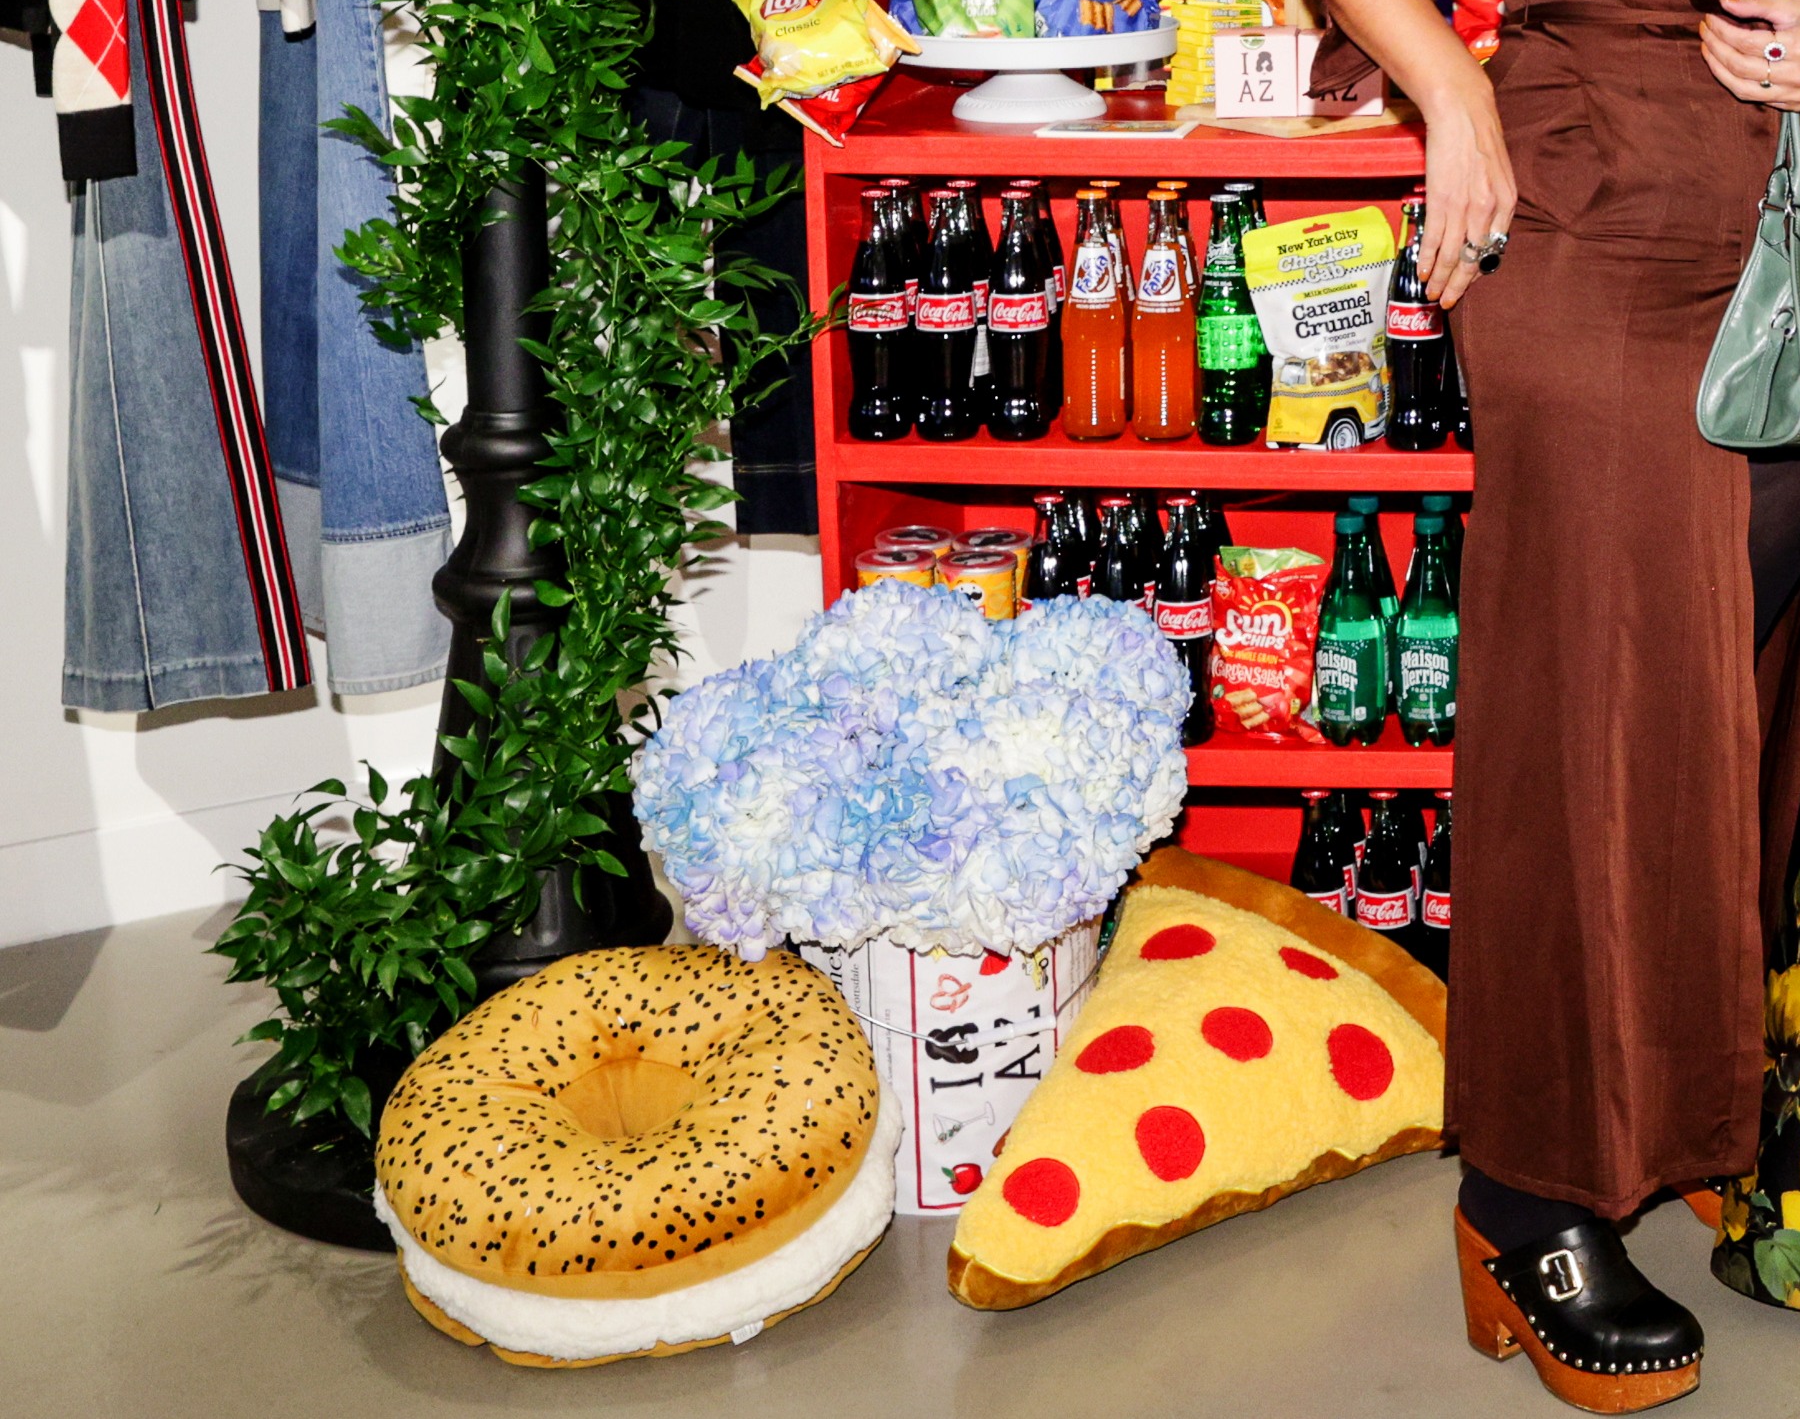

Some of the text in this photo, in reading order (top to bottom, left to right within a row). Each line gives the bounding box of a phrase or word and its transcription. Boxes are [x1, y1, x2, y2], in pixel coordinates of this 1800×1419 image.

[774, 16, 822, 38] Classic
[1238, 79, 1274, 103] AZ
[1277, 228, 1359, 256] New York City
[1276, 240, 1364, 273] Checker
[1304, 260, 1348, 285] Cab
[918, 300, 973, 323] Coca-Cola
[992, 300, 1047, 323] Coca-Cola
[1290, 290, 1372, 322] Caramel
[1294, 310, 1374, 339] Crunch
[1157, 608, 1211, 630] Coca-Cola
[1214, 607, 1292, 648] Sun
[1240, 633, 1286, 650] CHIPS
[1400, 650, 1450, 669] Maison
[1357, 897, 1407, 921] Coca-Cola
